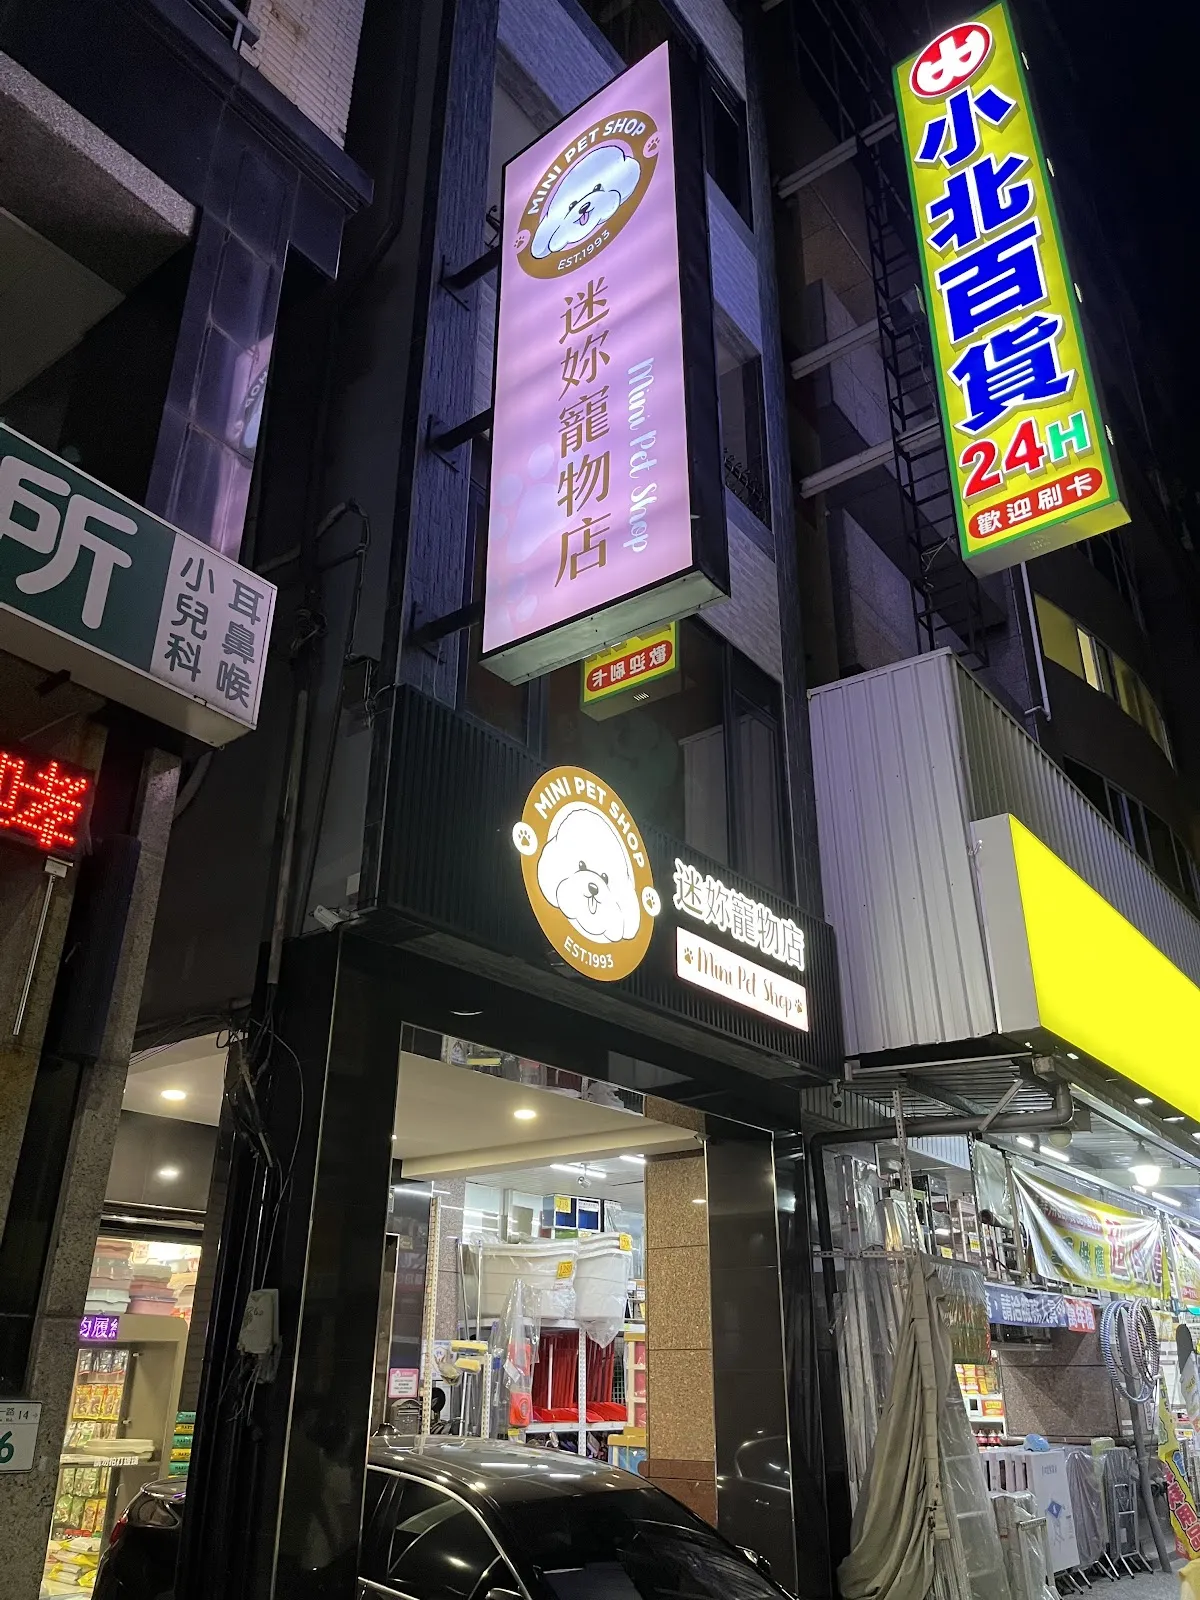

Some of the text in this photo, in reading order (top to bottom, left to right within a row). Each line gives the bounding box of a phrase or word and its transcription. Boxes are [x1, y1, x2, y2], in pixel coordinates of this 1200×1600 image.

[527, 117, 646, 216] MINI PET SHOP
[557, 229, 612, 271] EST.1993
[913, 85, 1078, 435] 小北百貨
[554, 276, 612, 588] 迷妳寵物店
[622, 357, 659, 554] Mini Pet Shop
[959, 410, 1091, 500] 24H
[0, 455, 139, 630] 所
[976, 473, 1093, 536] 歡迎刷卡
[164, 556, 216, 682] 小兒科
[216, 578, 266, 709] 耳鼻喉
[534, 776, 646, 869] MINI PET SHOP
[563, 935, 614, 969] EST.1993
[673, 858, 805, 971] 迷妳寵物店
[696, 946, 794, 1018] Mini Pet Shop
